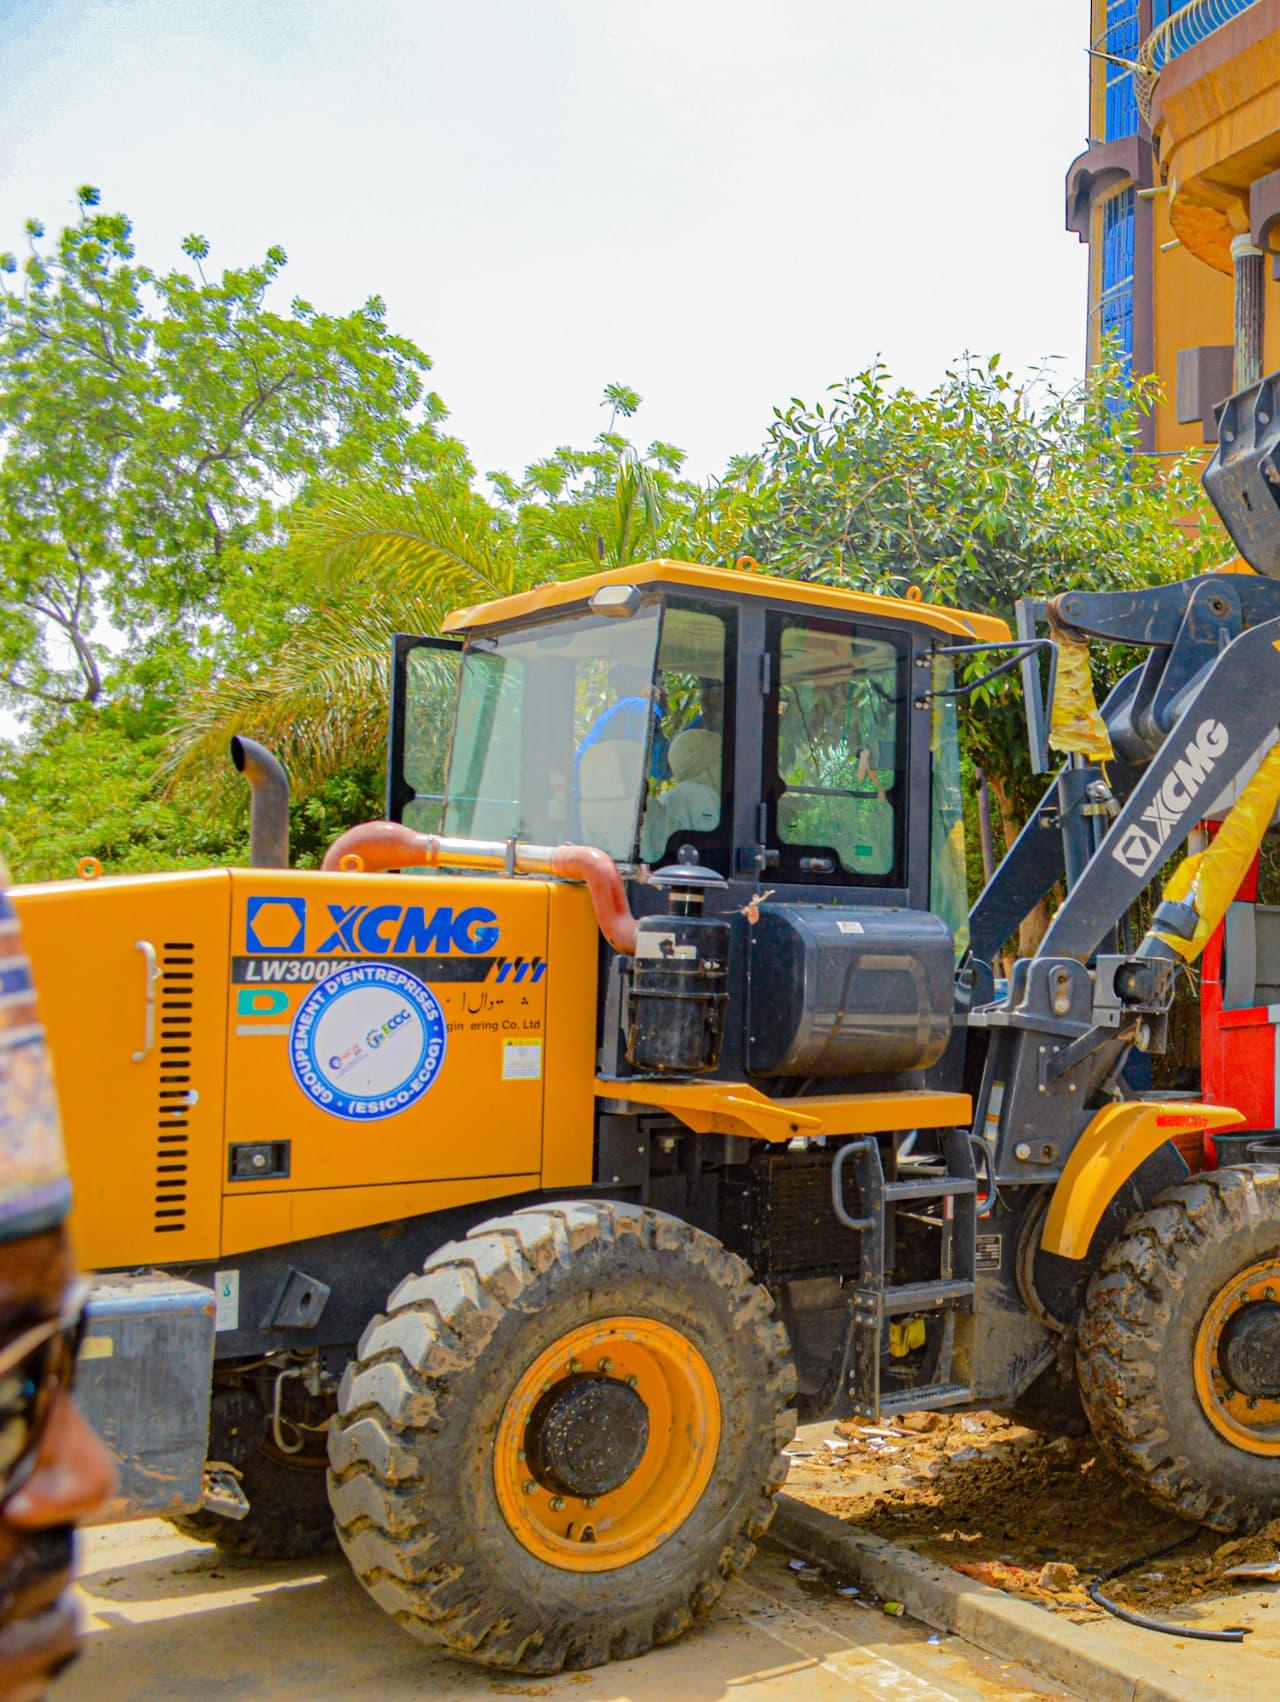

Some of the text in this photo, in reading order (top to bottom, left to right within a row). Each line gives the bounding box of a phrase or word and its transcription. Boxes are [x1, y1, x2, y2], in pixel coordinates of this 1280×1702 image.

[1141, 718, 1230, 845] XCMG
[315, 904, 500, 954] XCMG
[295, 991, 334, 1104] GROUPEMENT
